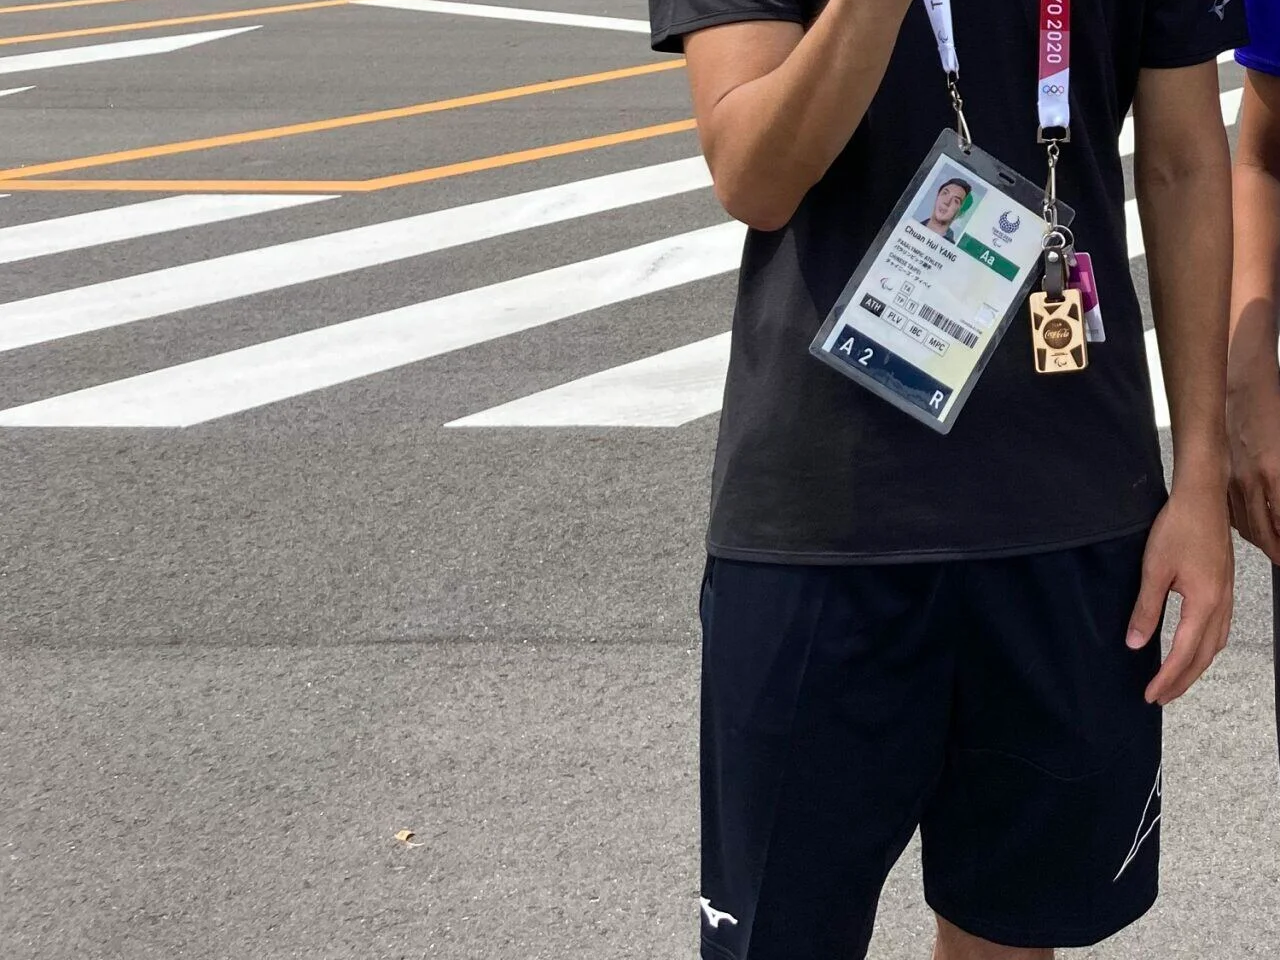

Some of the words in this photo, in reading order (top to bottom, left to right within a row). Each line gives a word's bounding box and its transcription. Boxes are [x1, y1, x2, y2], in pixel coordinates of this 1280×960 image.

[1046, 19, 1062, 64] 2020
[904, 225, 926, 243] Chuan
[939, 246, 957, 262] YANG
[980, 250, 995, 265] Aa
[865, 298, 881, 312] ATH
[887, 311, 902, 324] PLV
[909, 325, 923, 337] IBC
[928, 337, 945, 351] MPC
[839, 337, 855, 355] A
[858, 348, 874, 366] 2
[929, 390, 944, 409] R
